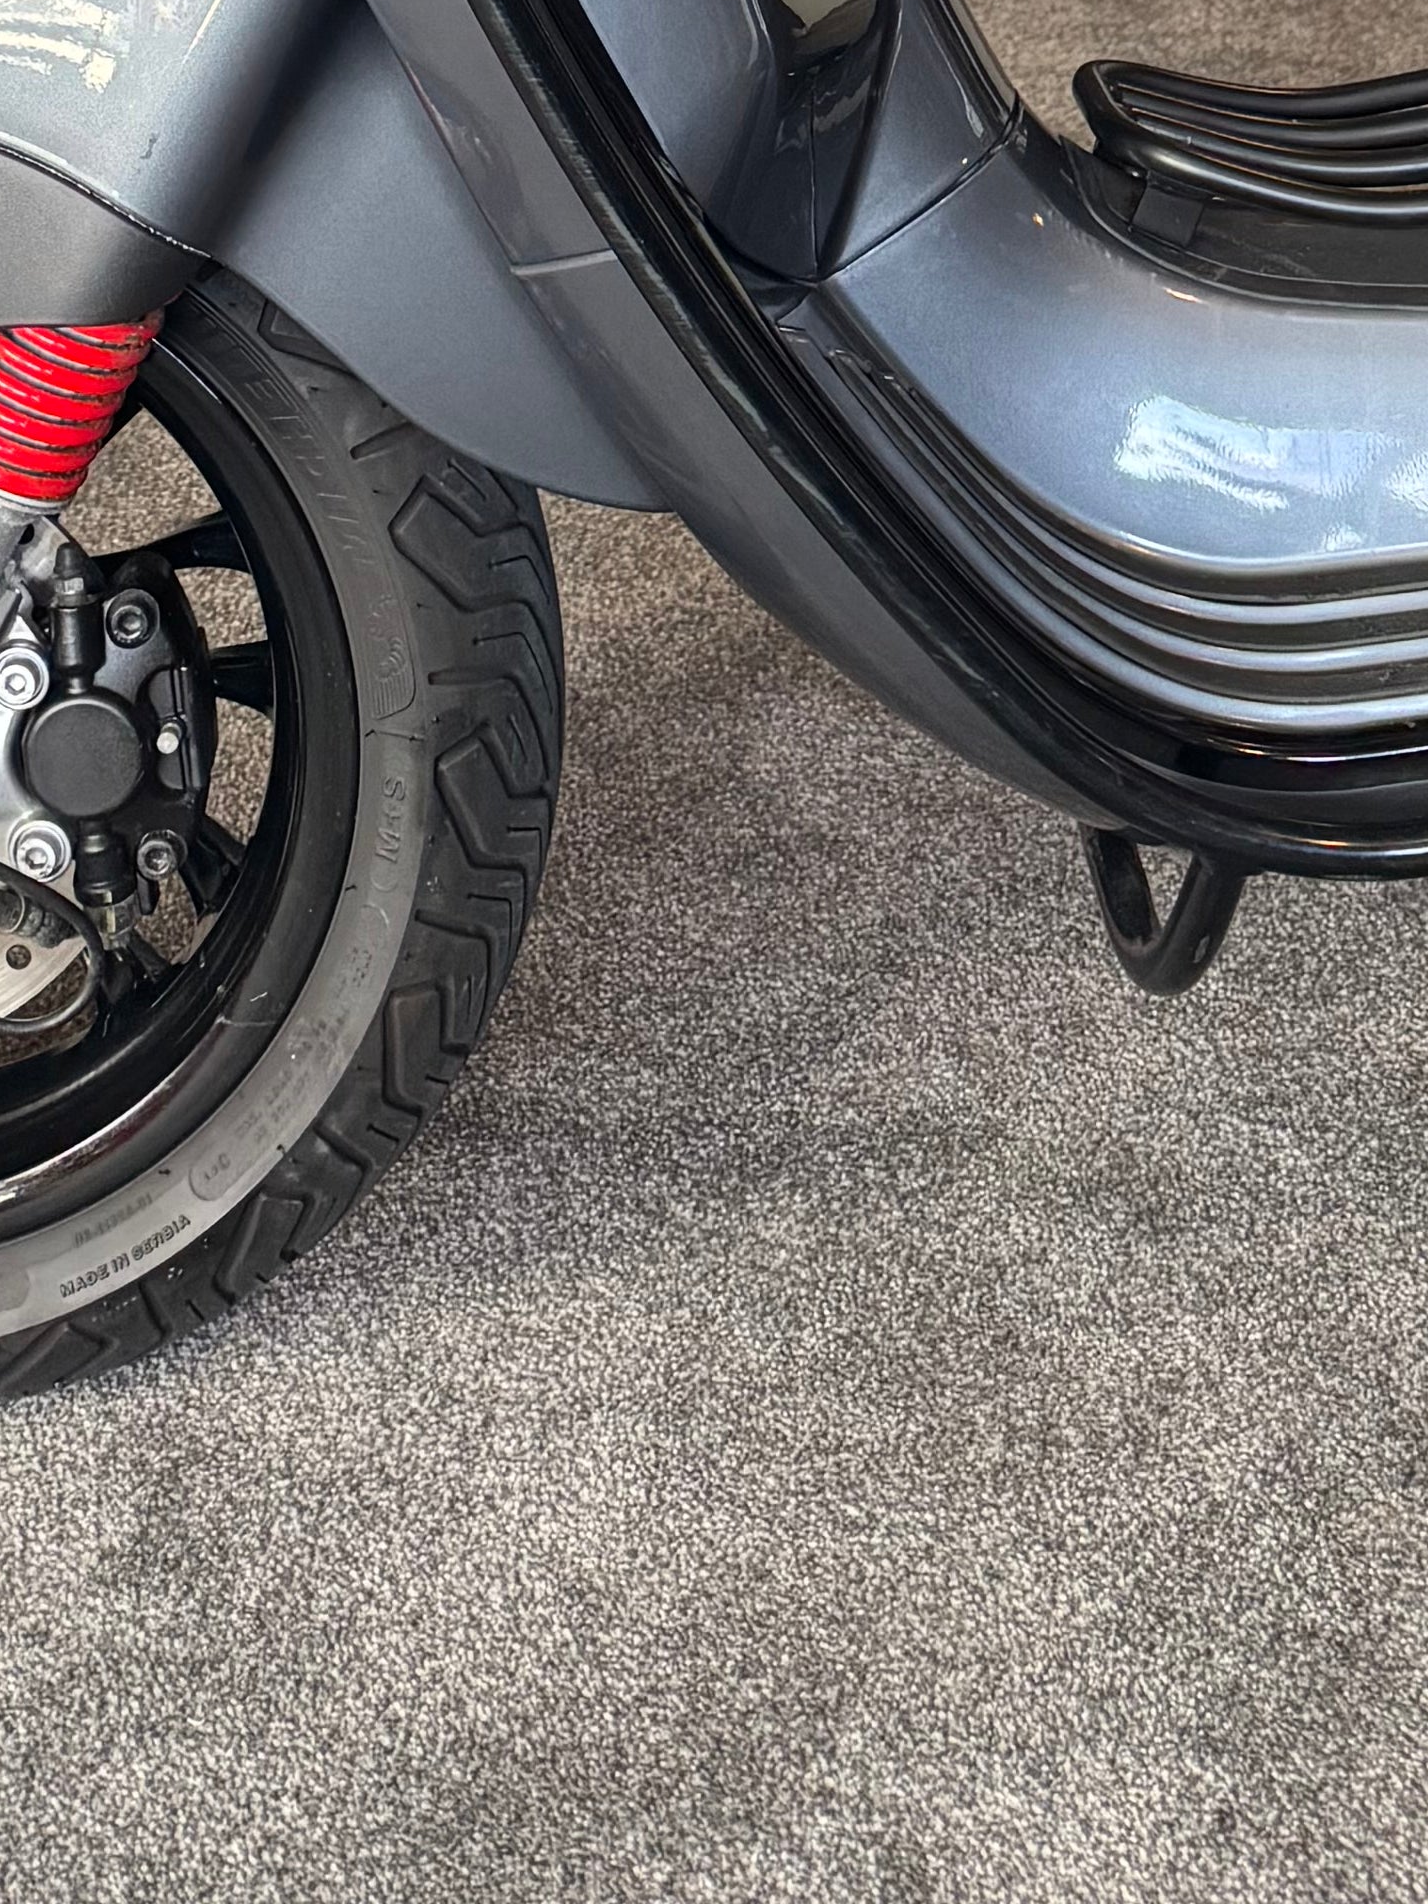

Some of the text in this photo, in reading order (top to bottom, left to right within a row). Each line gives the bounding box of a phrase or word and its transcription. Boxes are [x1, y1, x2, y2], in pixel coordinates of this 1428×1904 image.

[59, 1262, 111, 1298] MADE
[111, 1252, 131, 1273] IN
[130, 1213, 192, 1261] SERBIA
